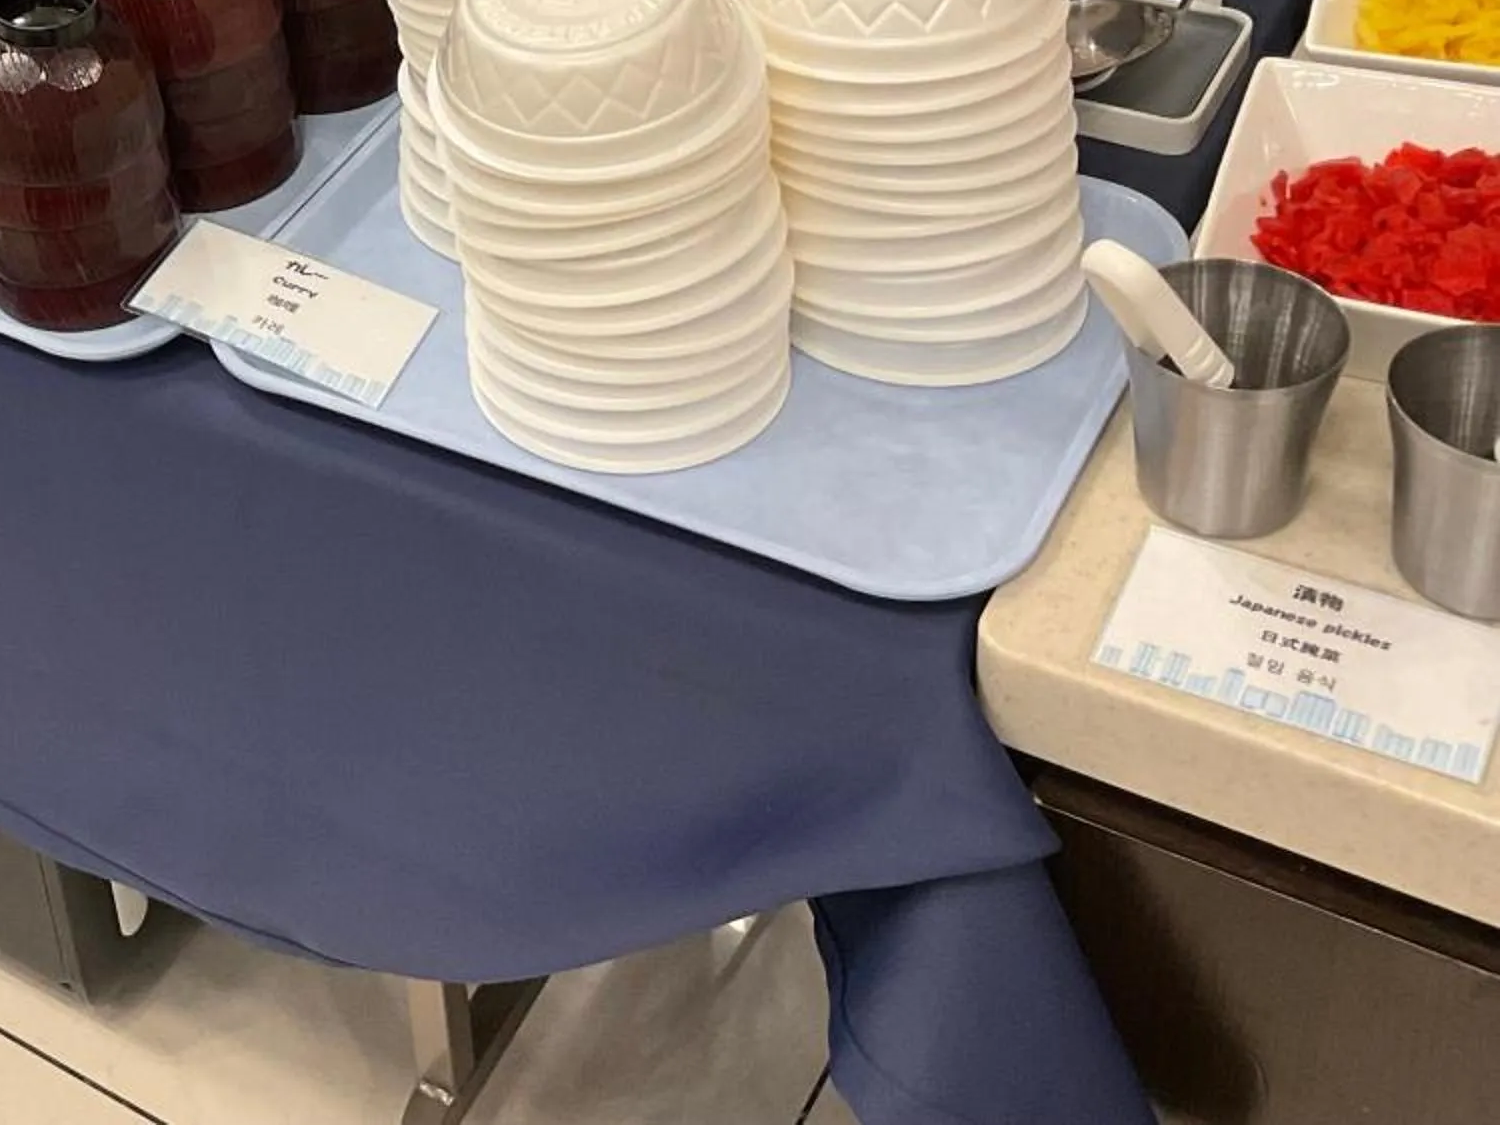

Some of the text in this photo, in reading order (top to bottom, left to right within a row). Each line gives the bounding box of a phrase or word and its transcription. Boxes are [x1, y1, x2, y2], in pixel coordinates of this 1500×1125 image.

[285, 260, 329, 280] カレー
[273, 276, 319, 299] Curry
[1229, 595, 1392, 650] Japanese pickles
